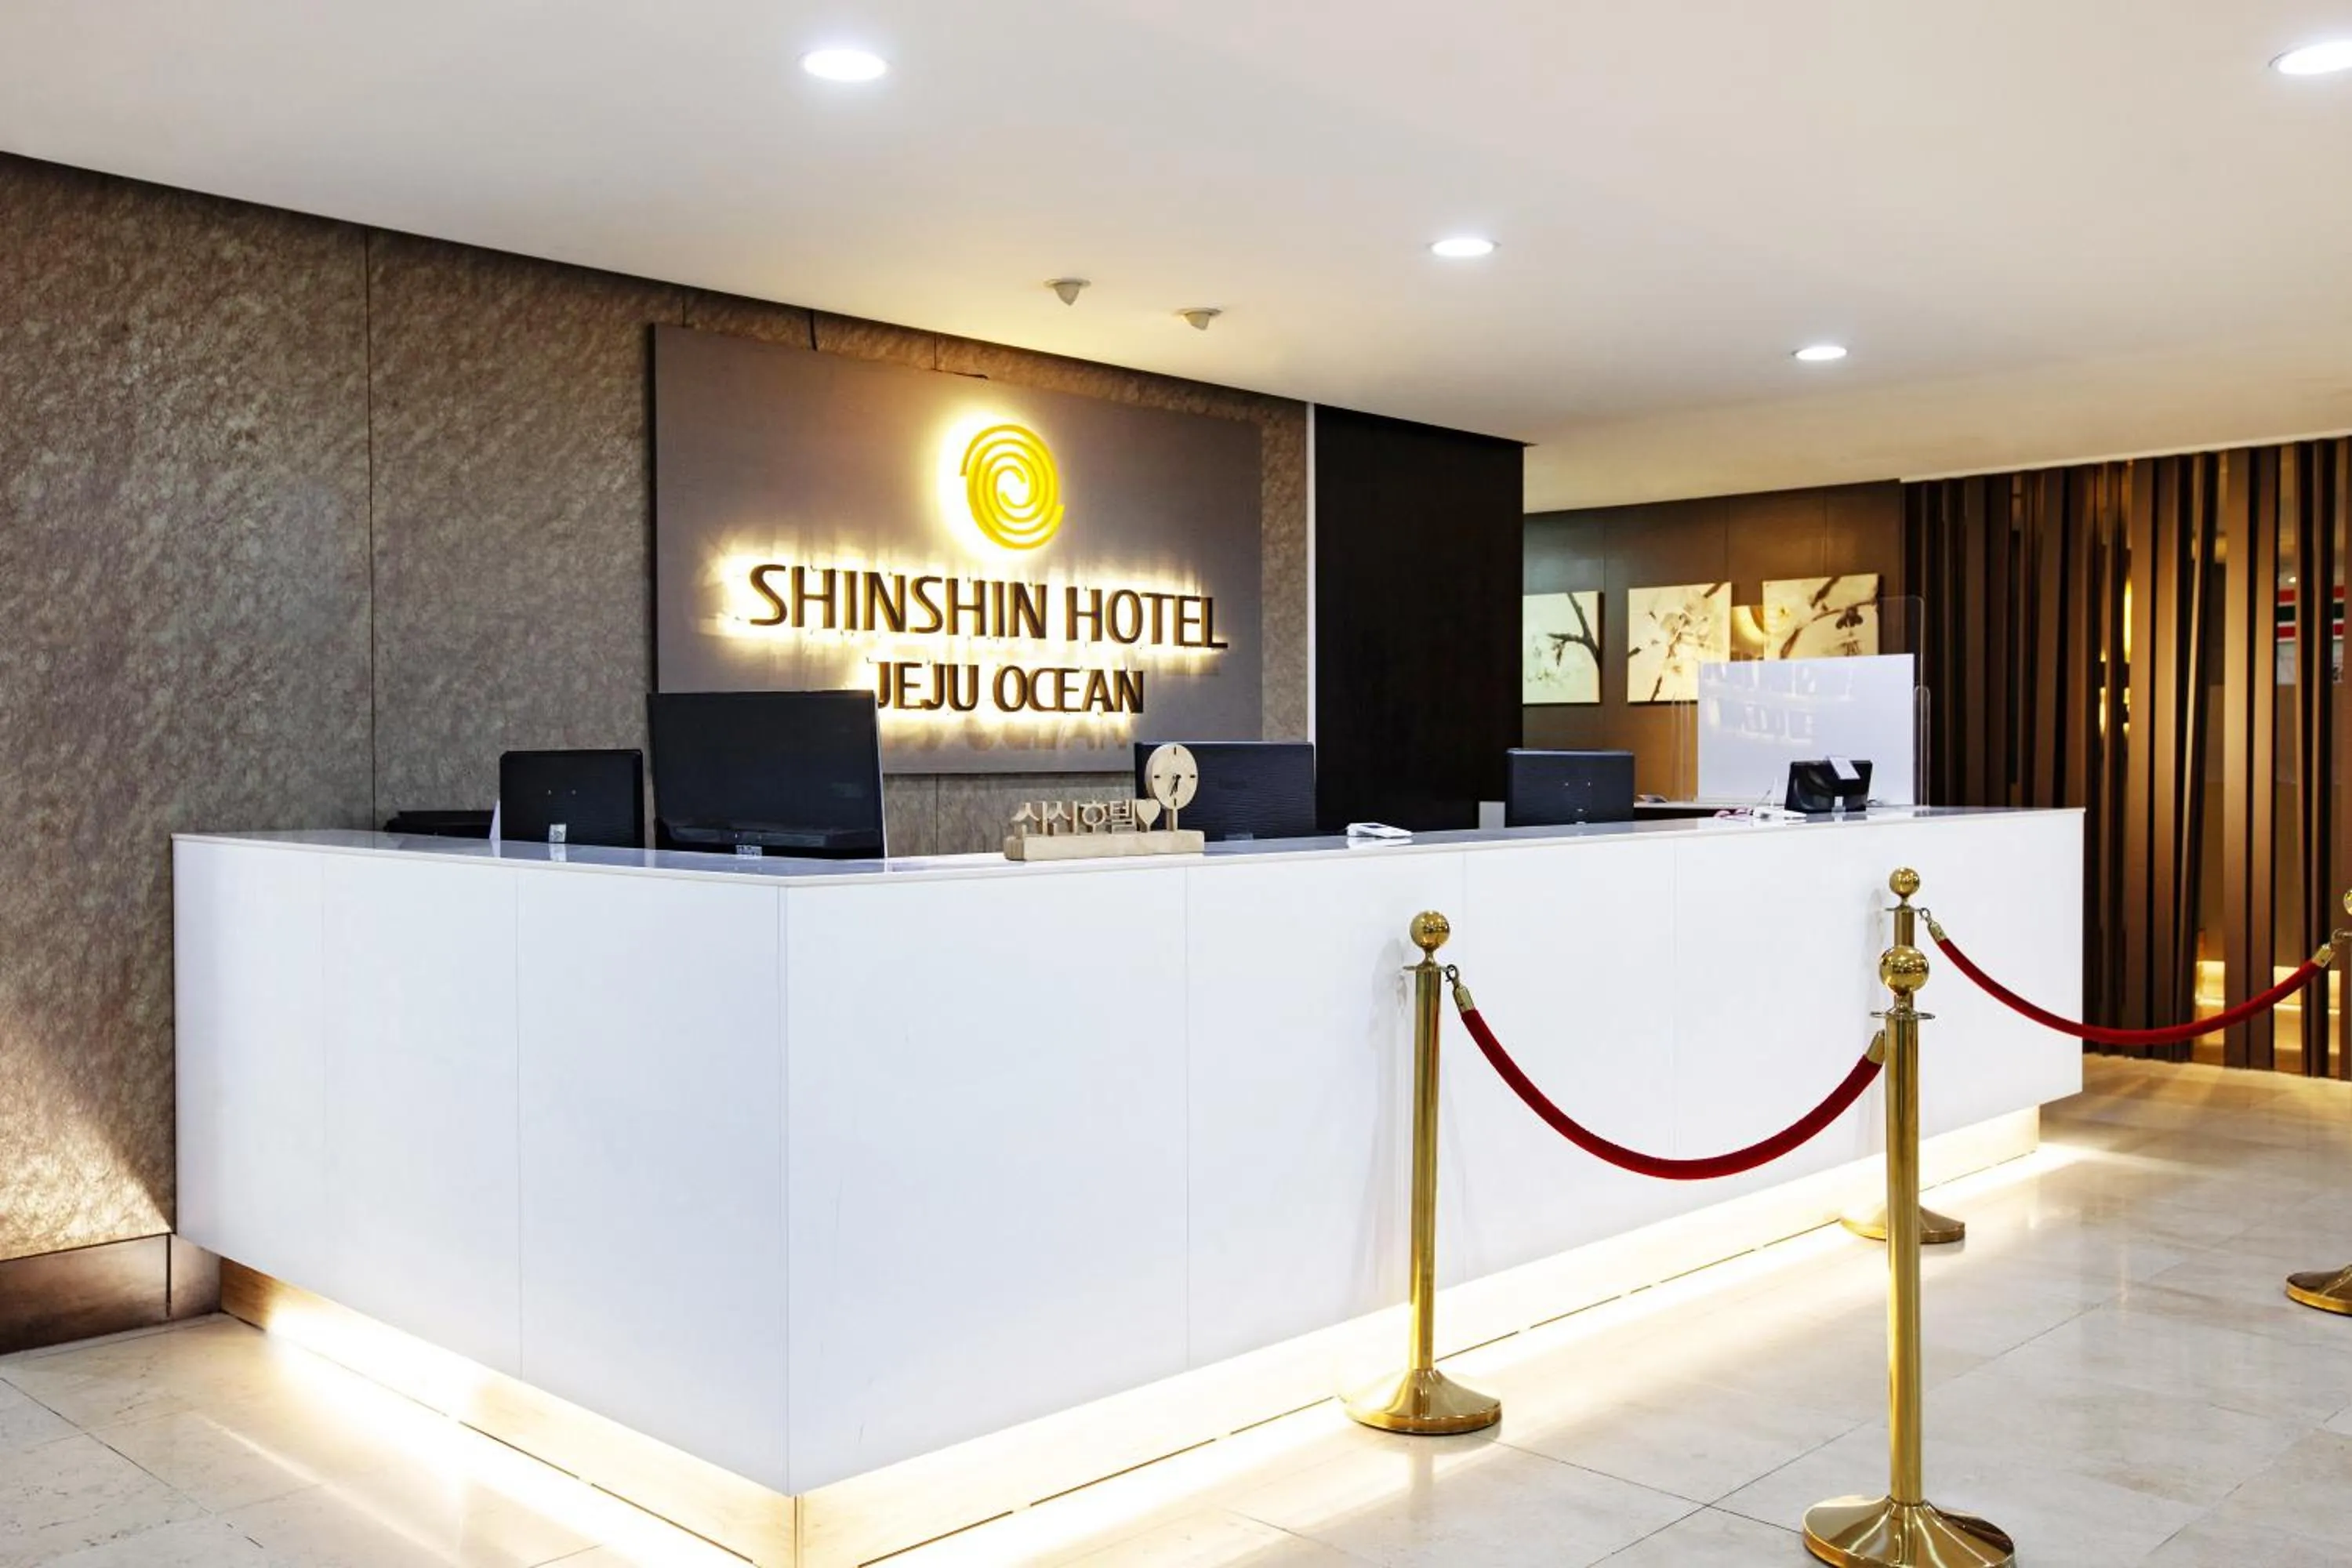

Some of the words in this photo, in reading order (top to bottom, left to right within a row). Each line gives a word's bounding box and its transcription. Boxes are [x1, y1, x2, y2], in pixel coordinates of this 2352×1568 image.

[749, 564, 1047, 640] SHINSHIN
[1065, 585, 1229, 649] HOTEL
[877, 661, 979, 711] JEJU
[993, 664, 1144, 713] OCEAN
[1011, 799, 1138, 837] 신신호텔
